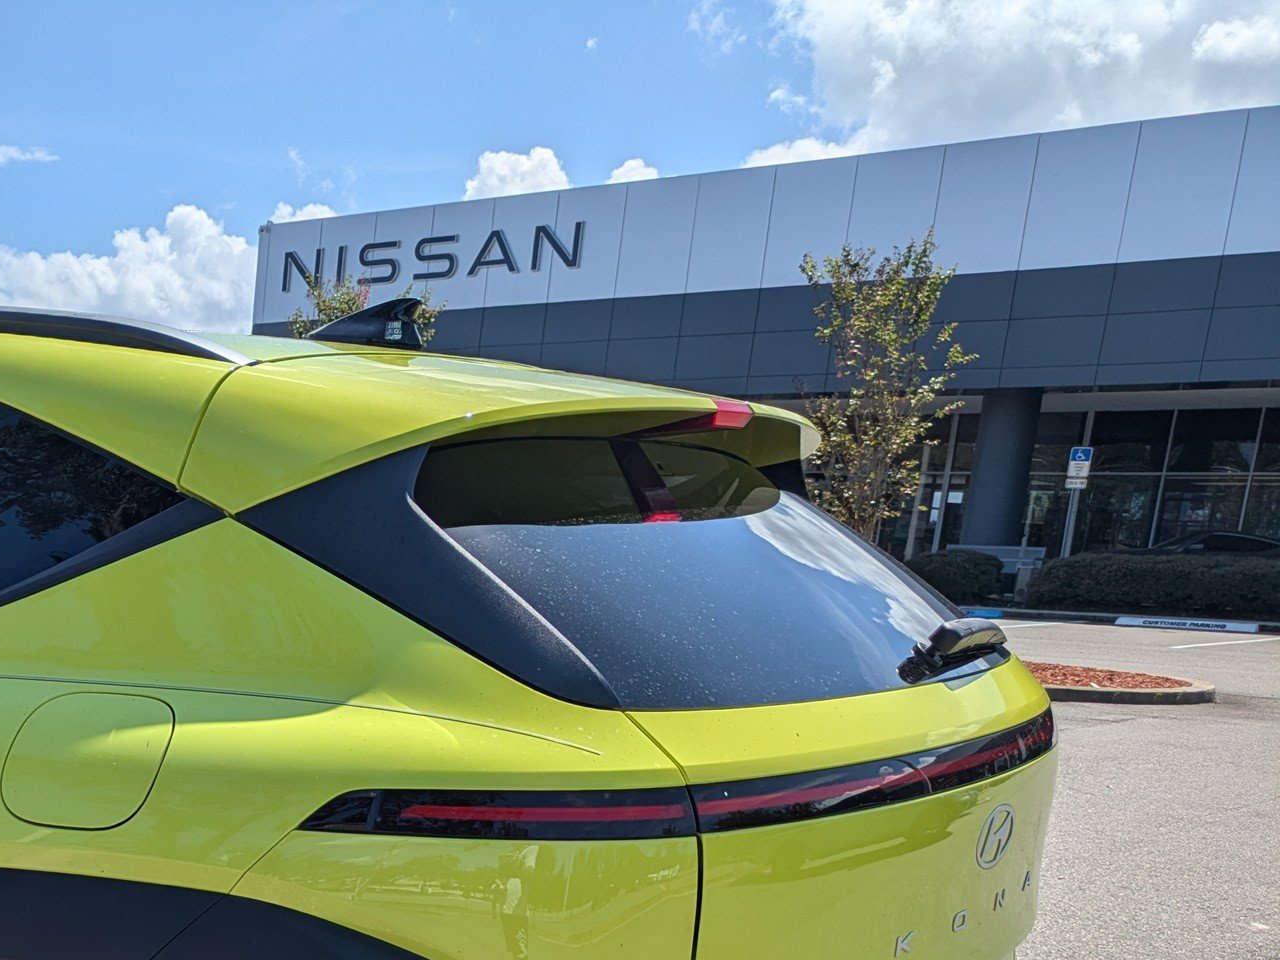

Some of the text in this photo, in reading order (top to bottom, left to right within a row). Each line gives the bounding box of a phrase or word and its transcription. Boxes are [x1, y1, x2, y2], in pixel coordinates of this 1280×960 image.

[281, 220, 585, 293] NISSAN
[1142, 619, 1227, 629] CUSTOMER PARKING
[894, 870, 1032, 958] KONA
